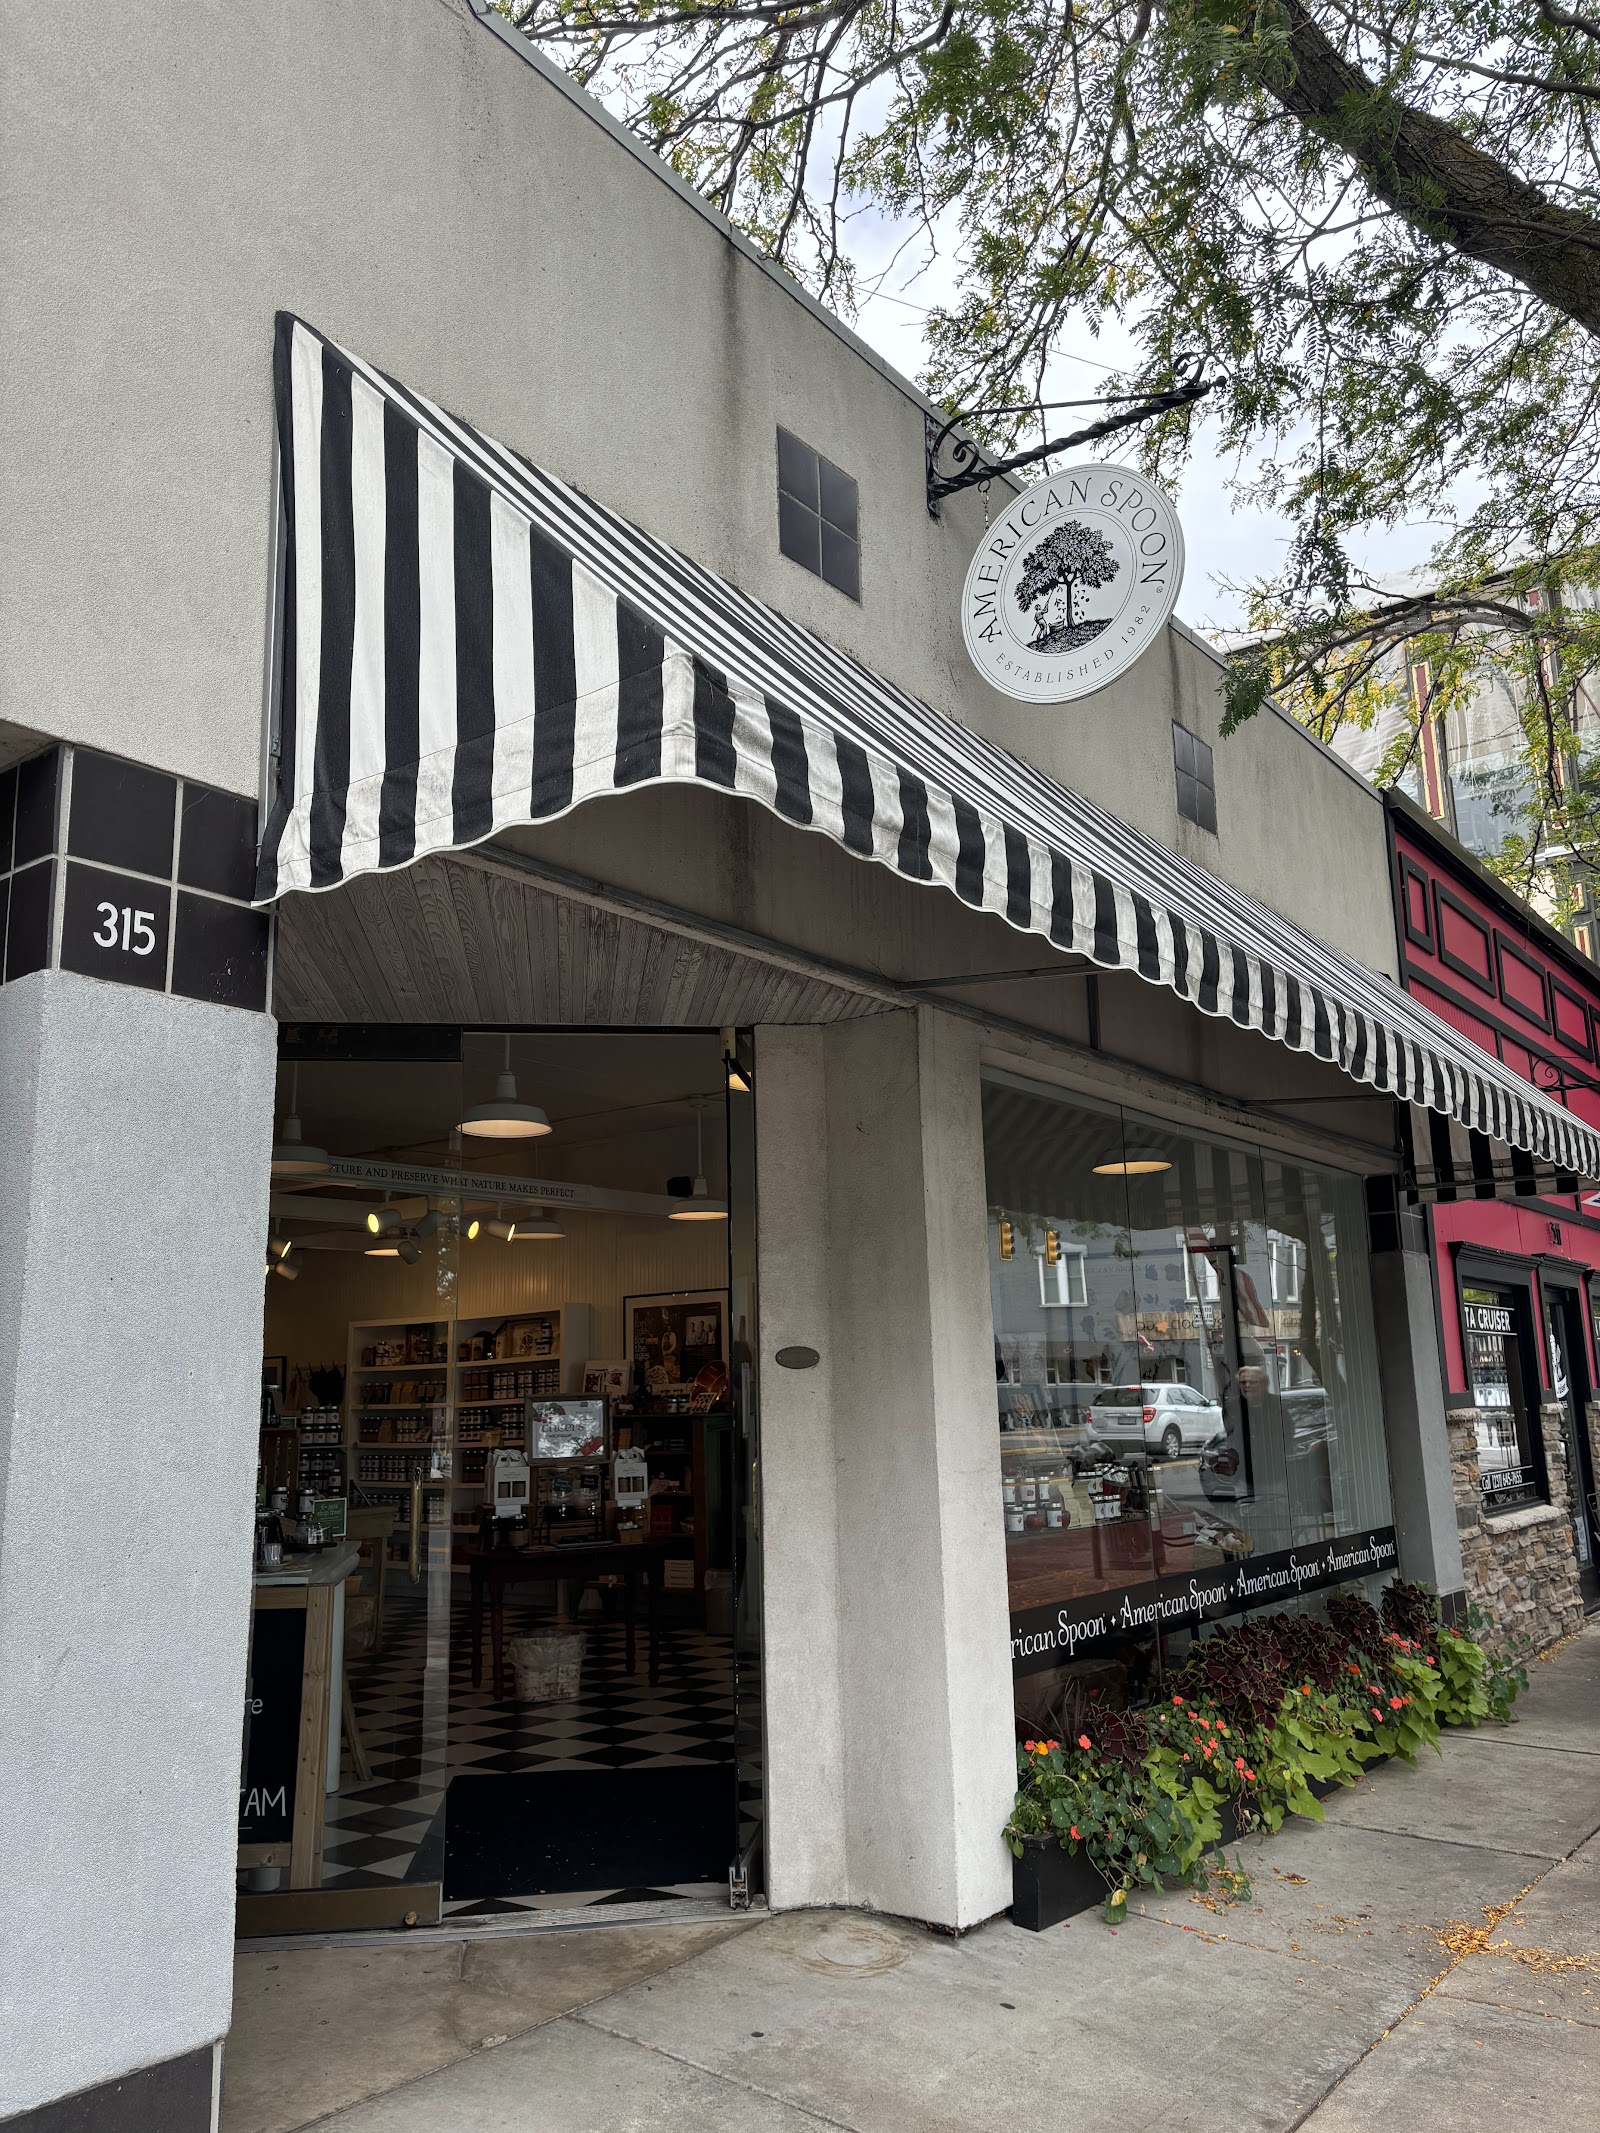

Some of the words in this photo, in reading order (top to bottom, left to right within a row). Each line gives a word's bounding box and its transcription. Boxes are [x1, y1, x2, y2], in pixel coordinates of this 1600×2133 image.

[973, 477, 1092, 643] AMERICAN
[1100, 480, 1168, 585] SPOON
[995, 648, 1115, 683] ESTABLISHED
[1120, 604, 1151, 644] 1982
[93, 901, 156, 955] 315
[365, 1167, 388, 1178] AND
[391, 1169, 438, 1184] PRESERVE
[441, 1175, 469, 1187] WHAT
[471, 1178, 507, 1191] NATURE
[509, 1182, 539, 1194] MAKES
[540, 1186, 575, 1198] PERFECT
[1478, 1308, 1511, 1332] CRUISER
[1481, 1474, 1491, 1490] Call
[1057, 1609, 1107, 1656] Spoon
[1120, 1593, 1189, 1630] American
[1189, 1578, 1228, 1619] Spoon
[1236, 1567, 1291, 1598] American
[1289, 1554, 1321, 1591] Spoon
[1327, 1546, 1371, 1573] American
[1369, 1536, 1396, 1569] Spoon
[240, 1785, 287, 1817] AM
